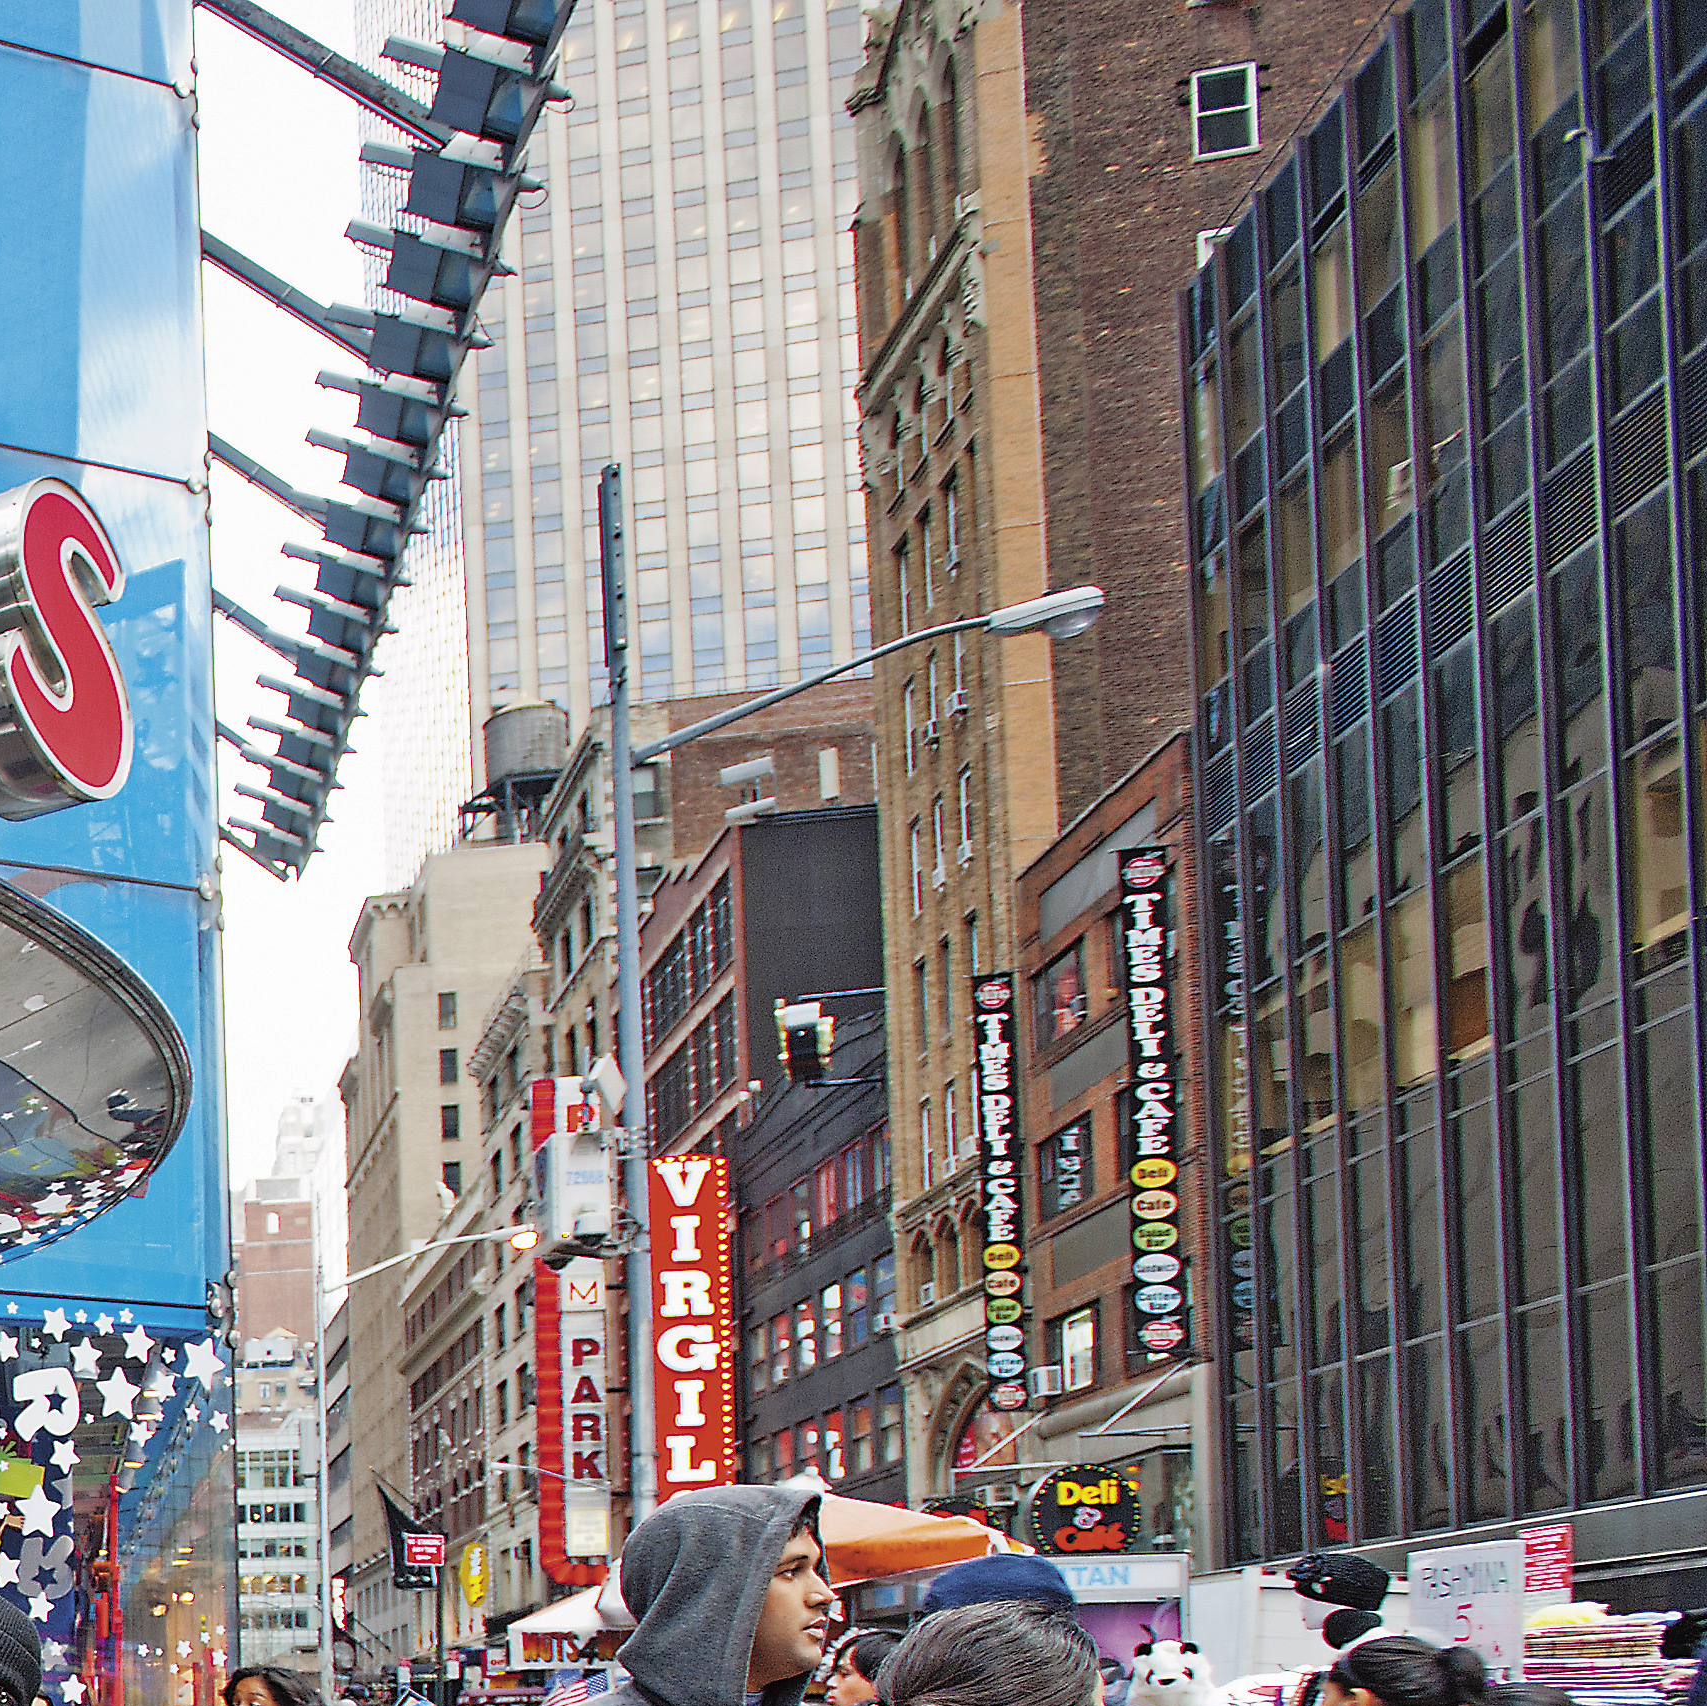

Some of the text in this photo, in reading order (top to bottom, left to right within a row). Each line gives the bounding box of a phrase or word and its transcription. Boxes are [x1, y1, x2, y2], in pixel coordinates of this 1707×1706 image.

[1123, 892, 1165, 982] TIMES
[978, 1013, 1011, 1091] TIMES
[1129, 987, 1168, 1057] DELI
[982, 1094, 1013, 1156] DELI
[656, 1160, 721, 1498] VIRGIL
[570, 1338, 602, 1479] PARK
[1056, 1479, 1120, 1506] Deli
